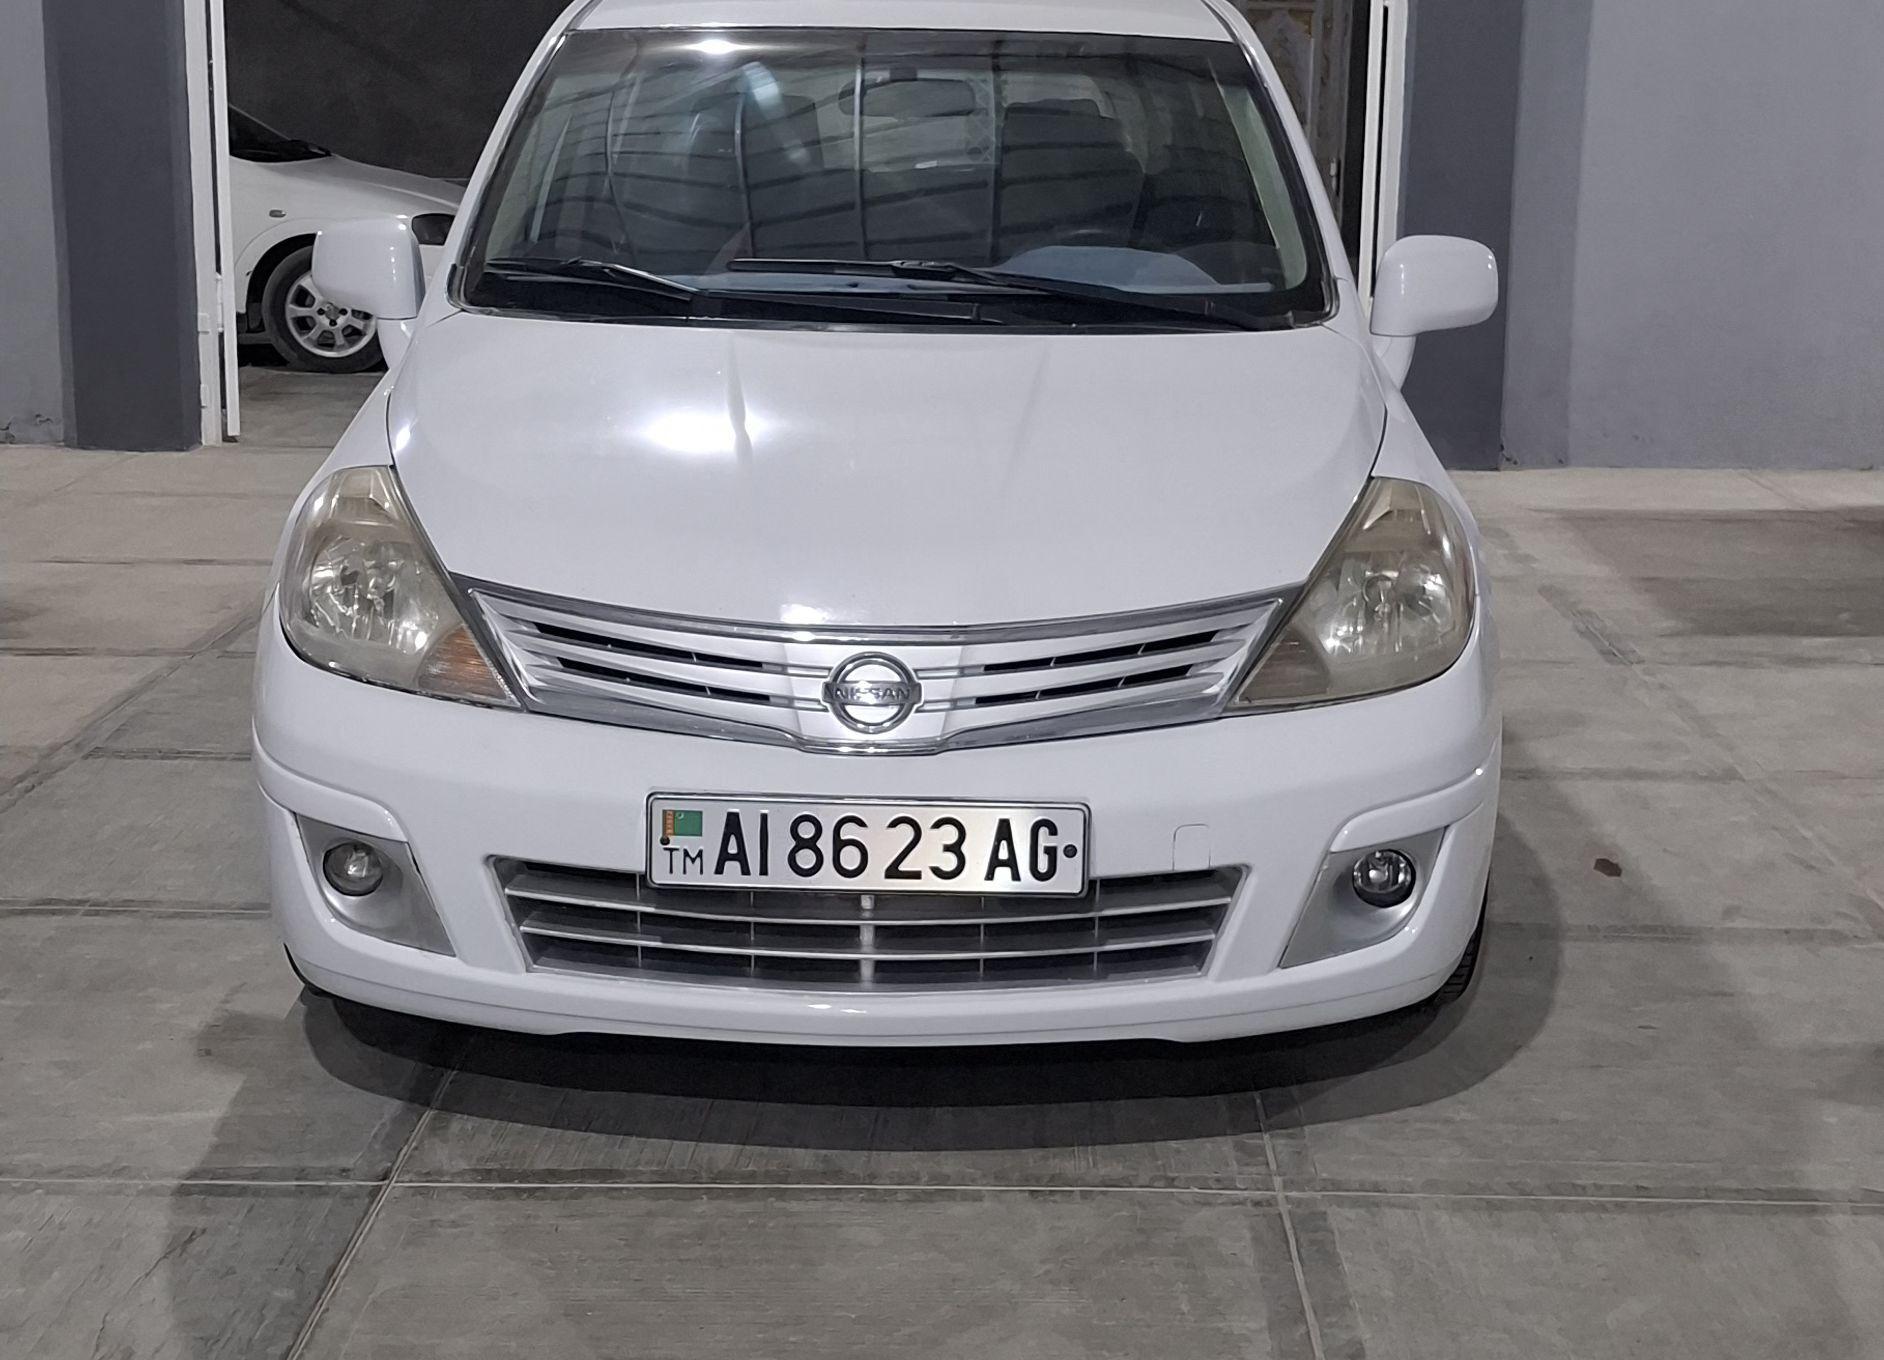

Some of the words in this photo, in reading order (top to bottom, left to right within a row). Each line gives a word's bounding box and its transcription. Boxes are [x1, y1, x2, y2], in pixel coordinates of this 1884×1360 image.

[662, 847, 704, 876] TM
[713, 811, 770, 877] AI
[984, 817, 1058, 882] AG
